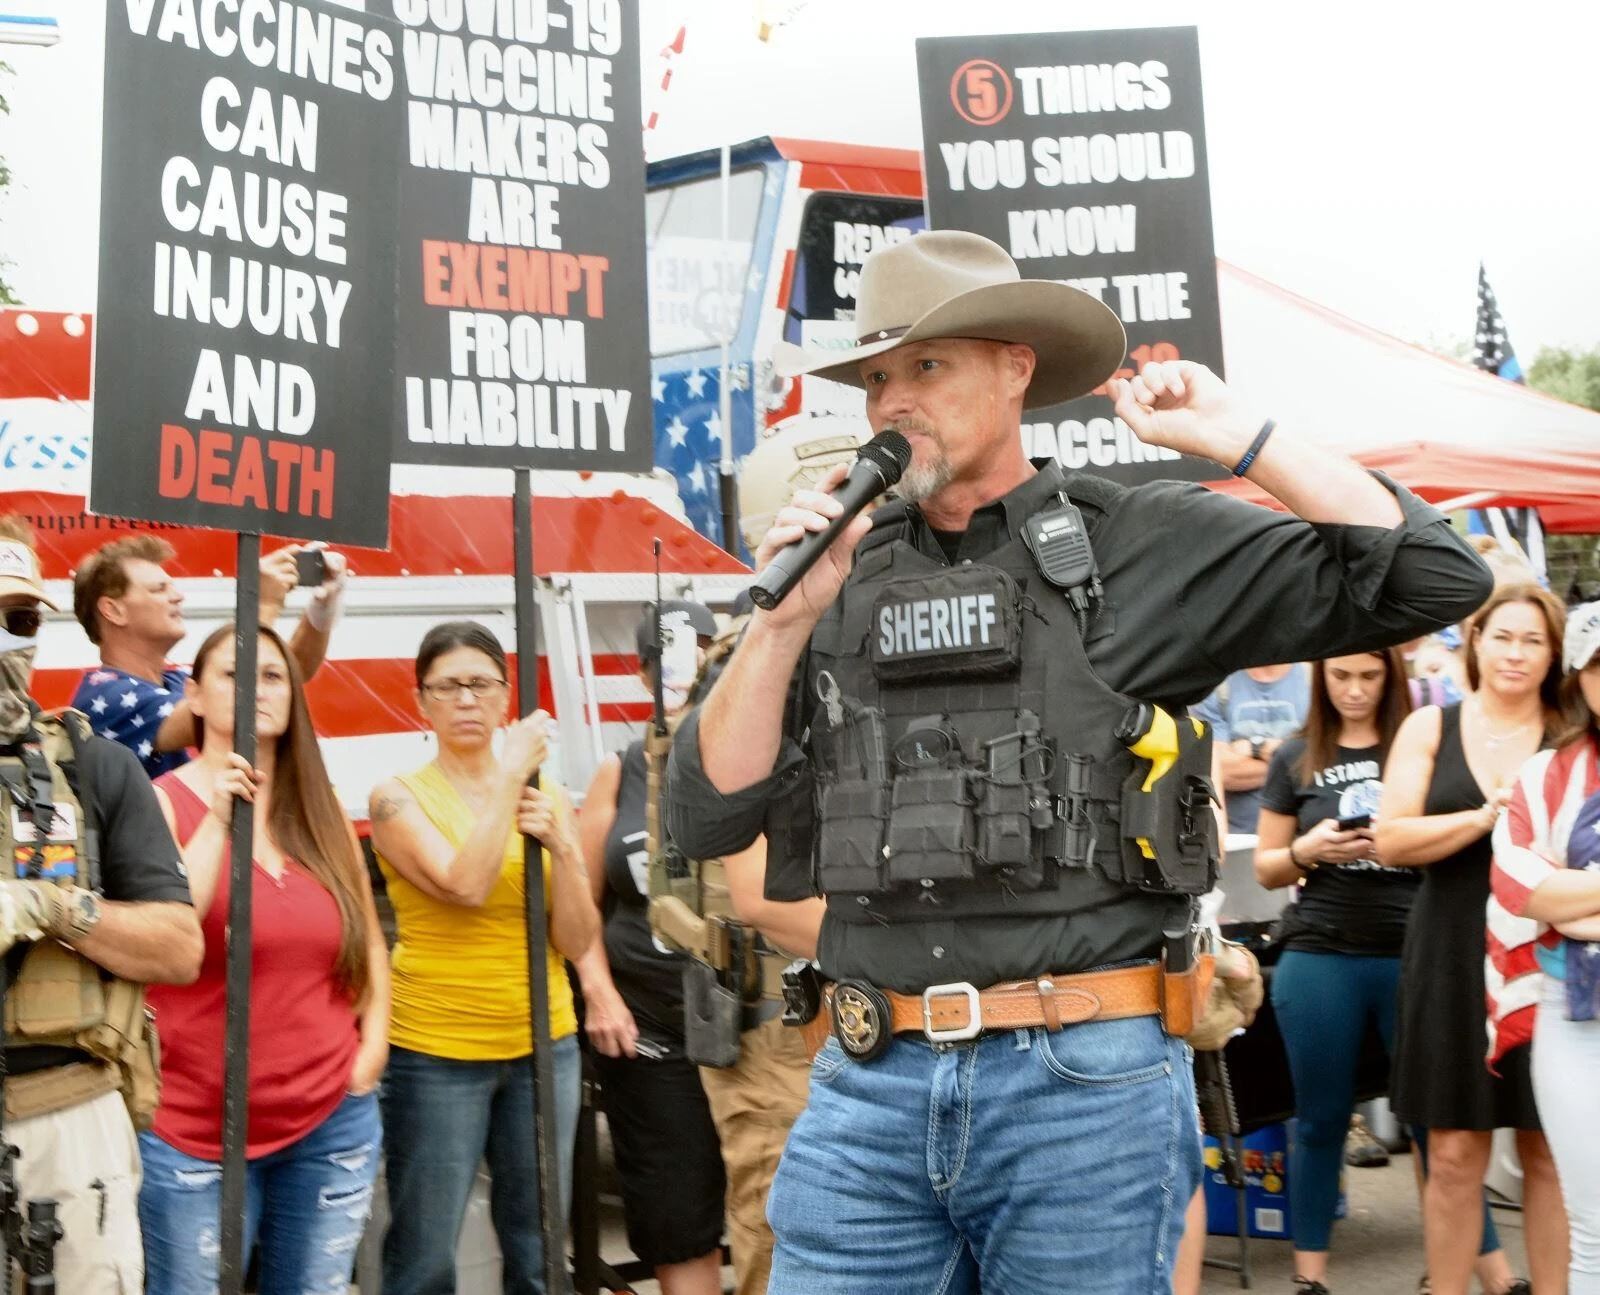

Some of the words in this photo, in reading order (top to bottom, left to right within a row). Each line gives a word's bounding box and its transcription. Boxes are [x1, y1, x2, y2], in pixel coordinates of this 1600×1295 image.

[403, 30, 614, 121] VACCINE
[966, 68, 998, 117] 5
[1014, 61, 1171, 116] THINGS
[200, 76, 319, 172] CAN
[408, 101, 611, 189] MAKERS
[939, 140, 1026, 191] YOU
[1032, 130, 1196, 186] SHOULD
[161, 156, 348, 265] CAUSE
[468, 178, 562, 250] ARE
[1007, 204, 1136, 260] KNOW
[153, 242, 352, 349] INJURY
[421, 239, 609, 318] EXEMPT
[1112, 271, 1192, 323] THE
[449, 311, 587, 383] FROM
[184, 349, 316, 436] AND
[405, 376, 632, 451] LIABILITY
[158, 423, 336, 519] DEATH
[879, 593, 996, 656] SHERIFF
[1313, 771, 1325, 787] I
[1324, 760, 1379, 785] STAND
